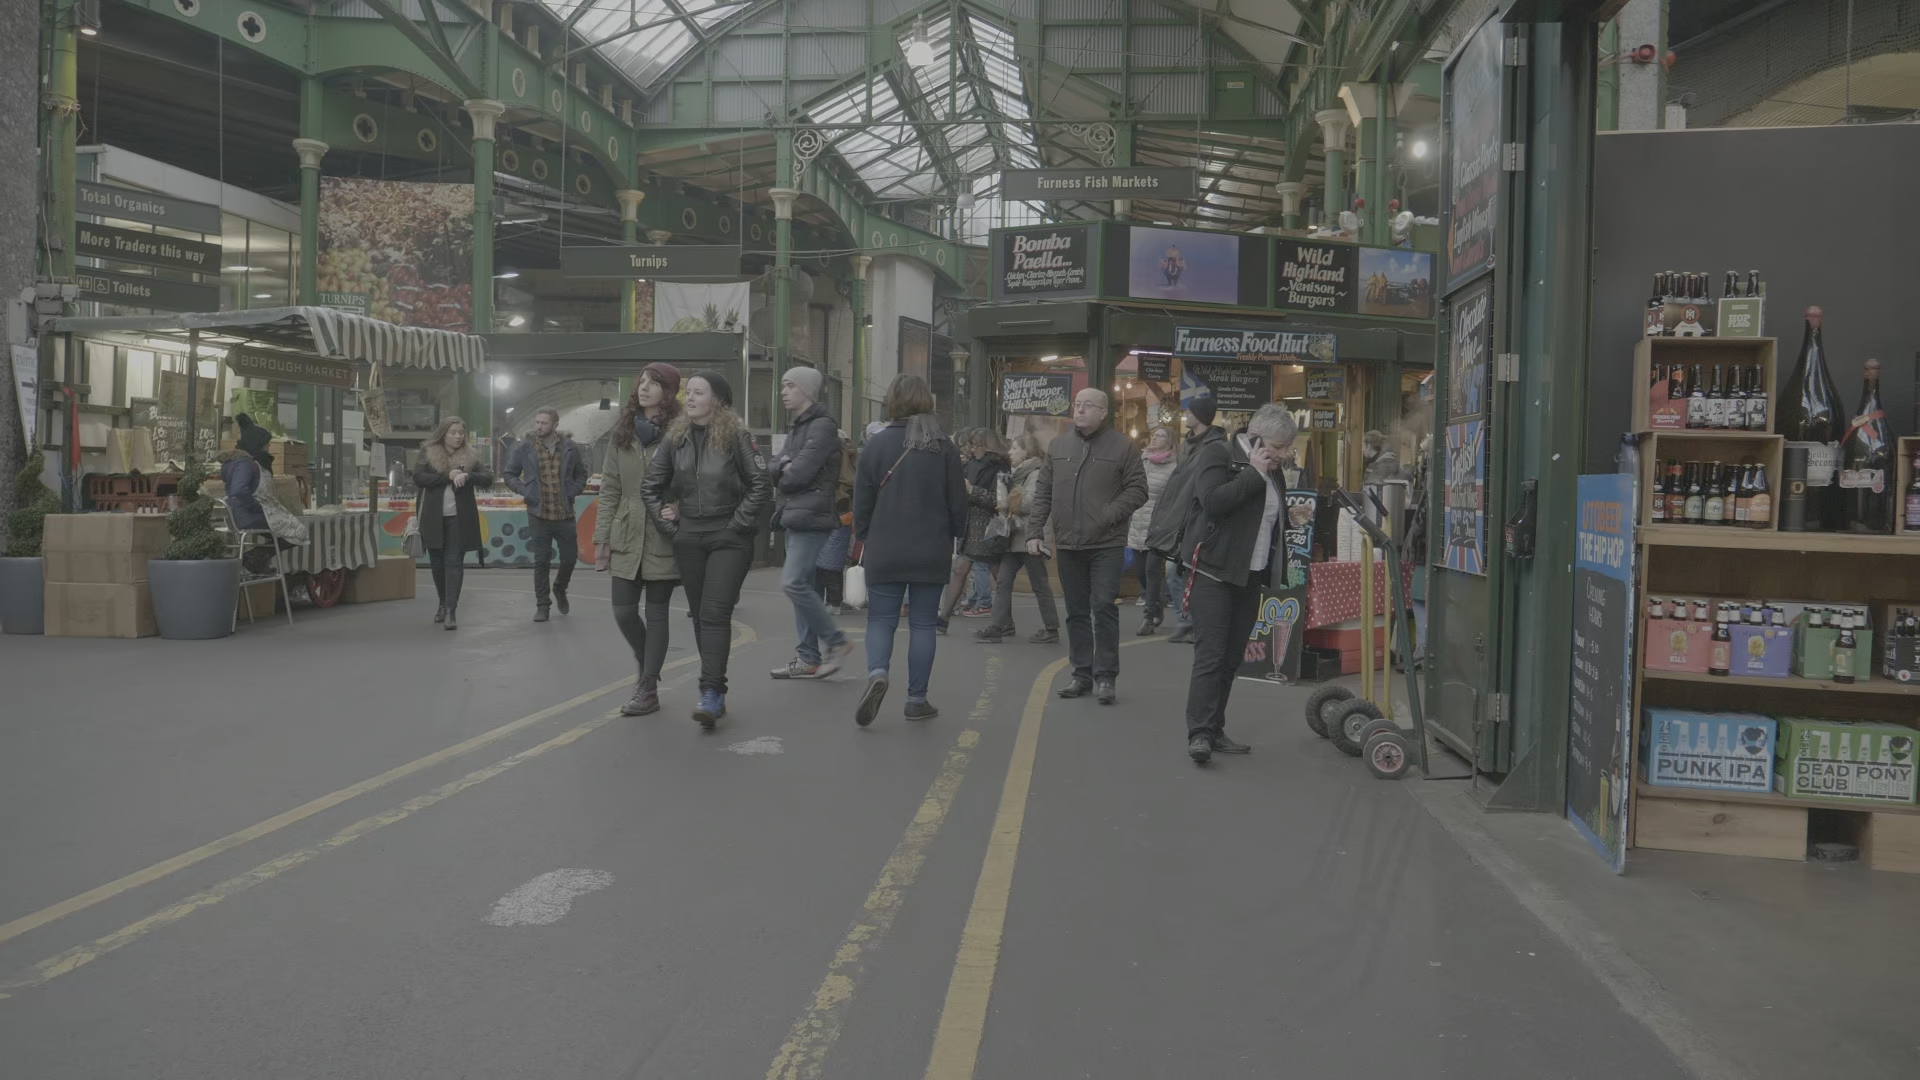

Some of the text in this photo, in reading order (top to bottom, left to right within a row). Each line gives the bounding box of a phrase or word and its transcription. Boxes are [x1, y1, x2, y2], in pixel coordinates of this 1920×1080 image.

[1037, 174, 1159, 189] Furness Fish Markets
[81, 188, 166, 216] Total Organics
[80, 230, 205, 265] More Traders this way
[1012, 233, 1071, 253] Bomba
[630, 254, 668, 270] Turnips
[1297, 246, 1335, 266] Wild
[1282, 262, 1345, 283] Highland
[112, 281, 152, 297] Toilets
[1288, 279, 1335, 295] Venison
[320, 293, 366, 306] TURNIPS
[1287, 292, 1336, 309] Burgers
[1728, 313, 1751, 322] HOP
[1175, 329, 1309, 353] Furness Food Hut
[1236, 352, 1257, 362] Freshly
[241, 355, 350, 380] BOROUGH MARKET
[1003, 376, 1048, 391] Shetlands
[1208, 374, 1260, 385] Steak Burgers
[1003, 386, 1063, 401] Salt & Pepper
[1002, 397, 1051, 412] Chilli Squid
[1314, 419, 1324, 428] Hot
[1324, 419, 1334, 428] Dog
[1451, 432, 1475, 490] English
[1578, 530, 1624, 568] THE HIP HOP
[1659, 720, 1671, 733] 24
[1800, 729, 1811, 740] 24
[1657, 758, 1766, 780] PUNK IPA
[1797, 762, 1913, 782] DEAD PONY
[1796, 775, 1849, 791] CLUB
